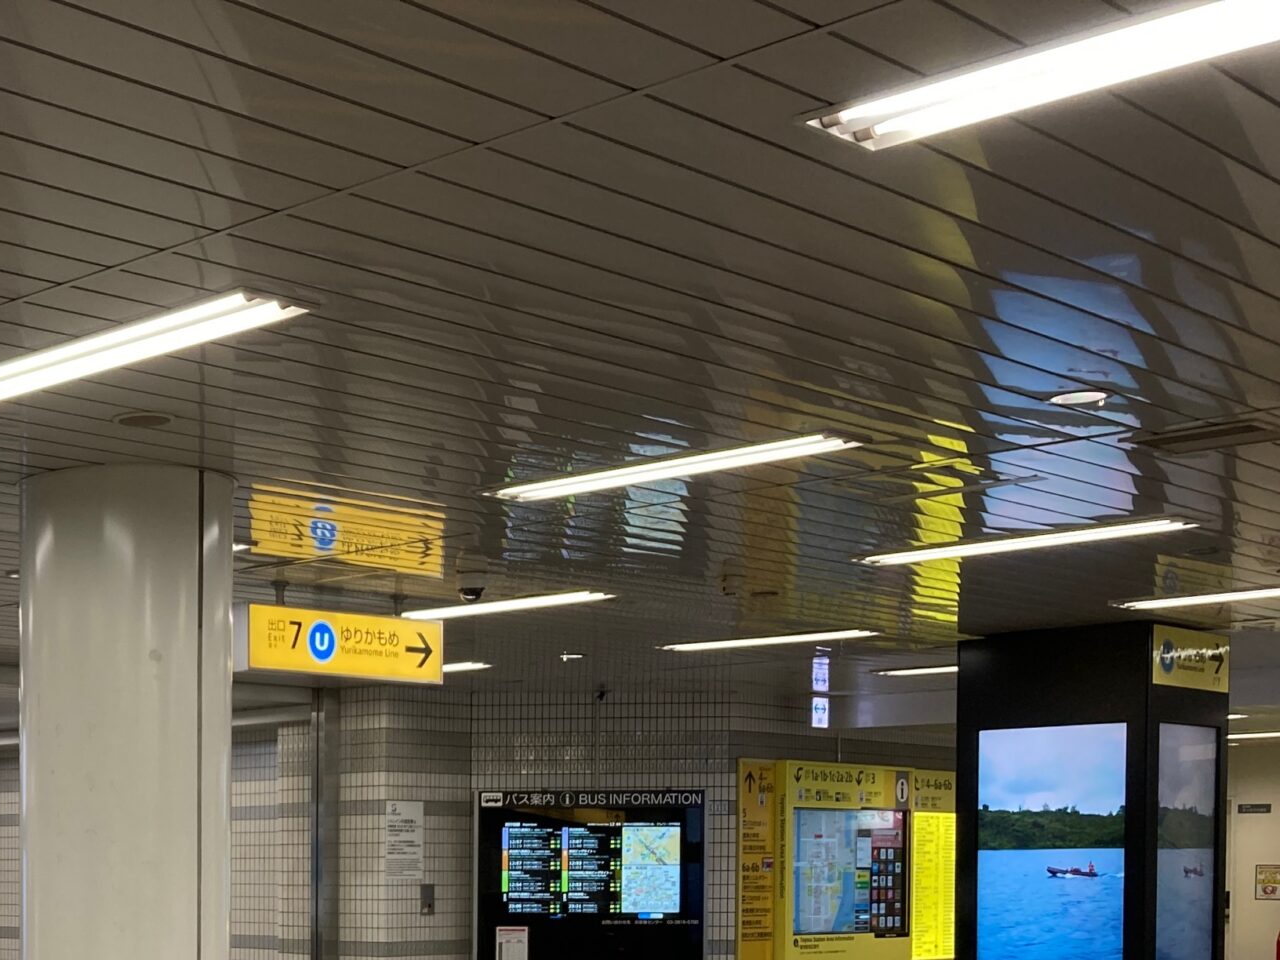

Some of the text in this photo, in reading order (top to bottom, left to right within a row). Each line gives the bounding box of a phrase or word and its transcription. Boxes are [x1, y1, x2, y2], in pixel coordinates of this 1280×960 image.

[267, 619, 286, 632] 出口
[267, 633, 286, 643] Exit
[289, 620, 303, 650] 7
[314, 631, 330, 651] U
[340, 625, 400, 648] ゆりかもめ
[340, 646, 400, 659] Yurikamome Line
[505, 793, 555, 806] バス案内
[579, 793, 702, 805] BUS INFORMATION
